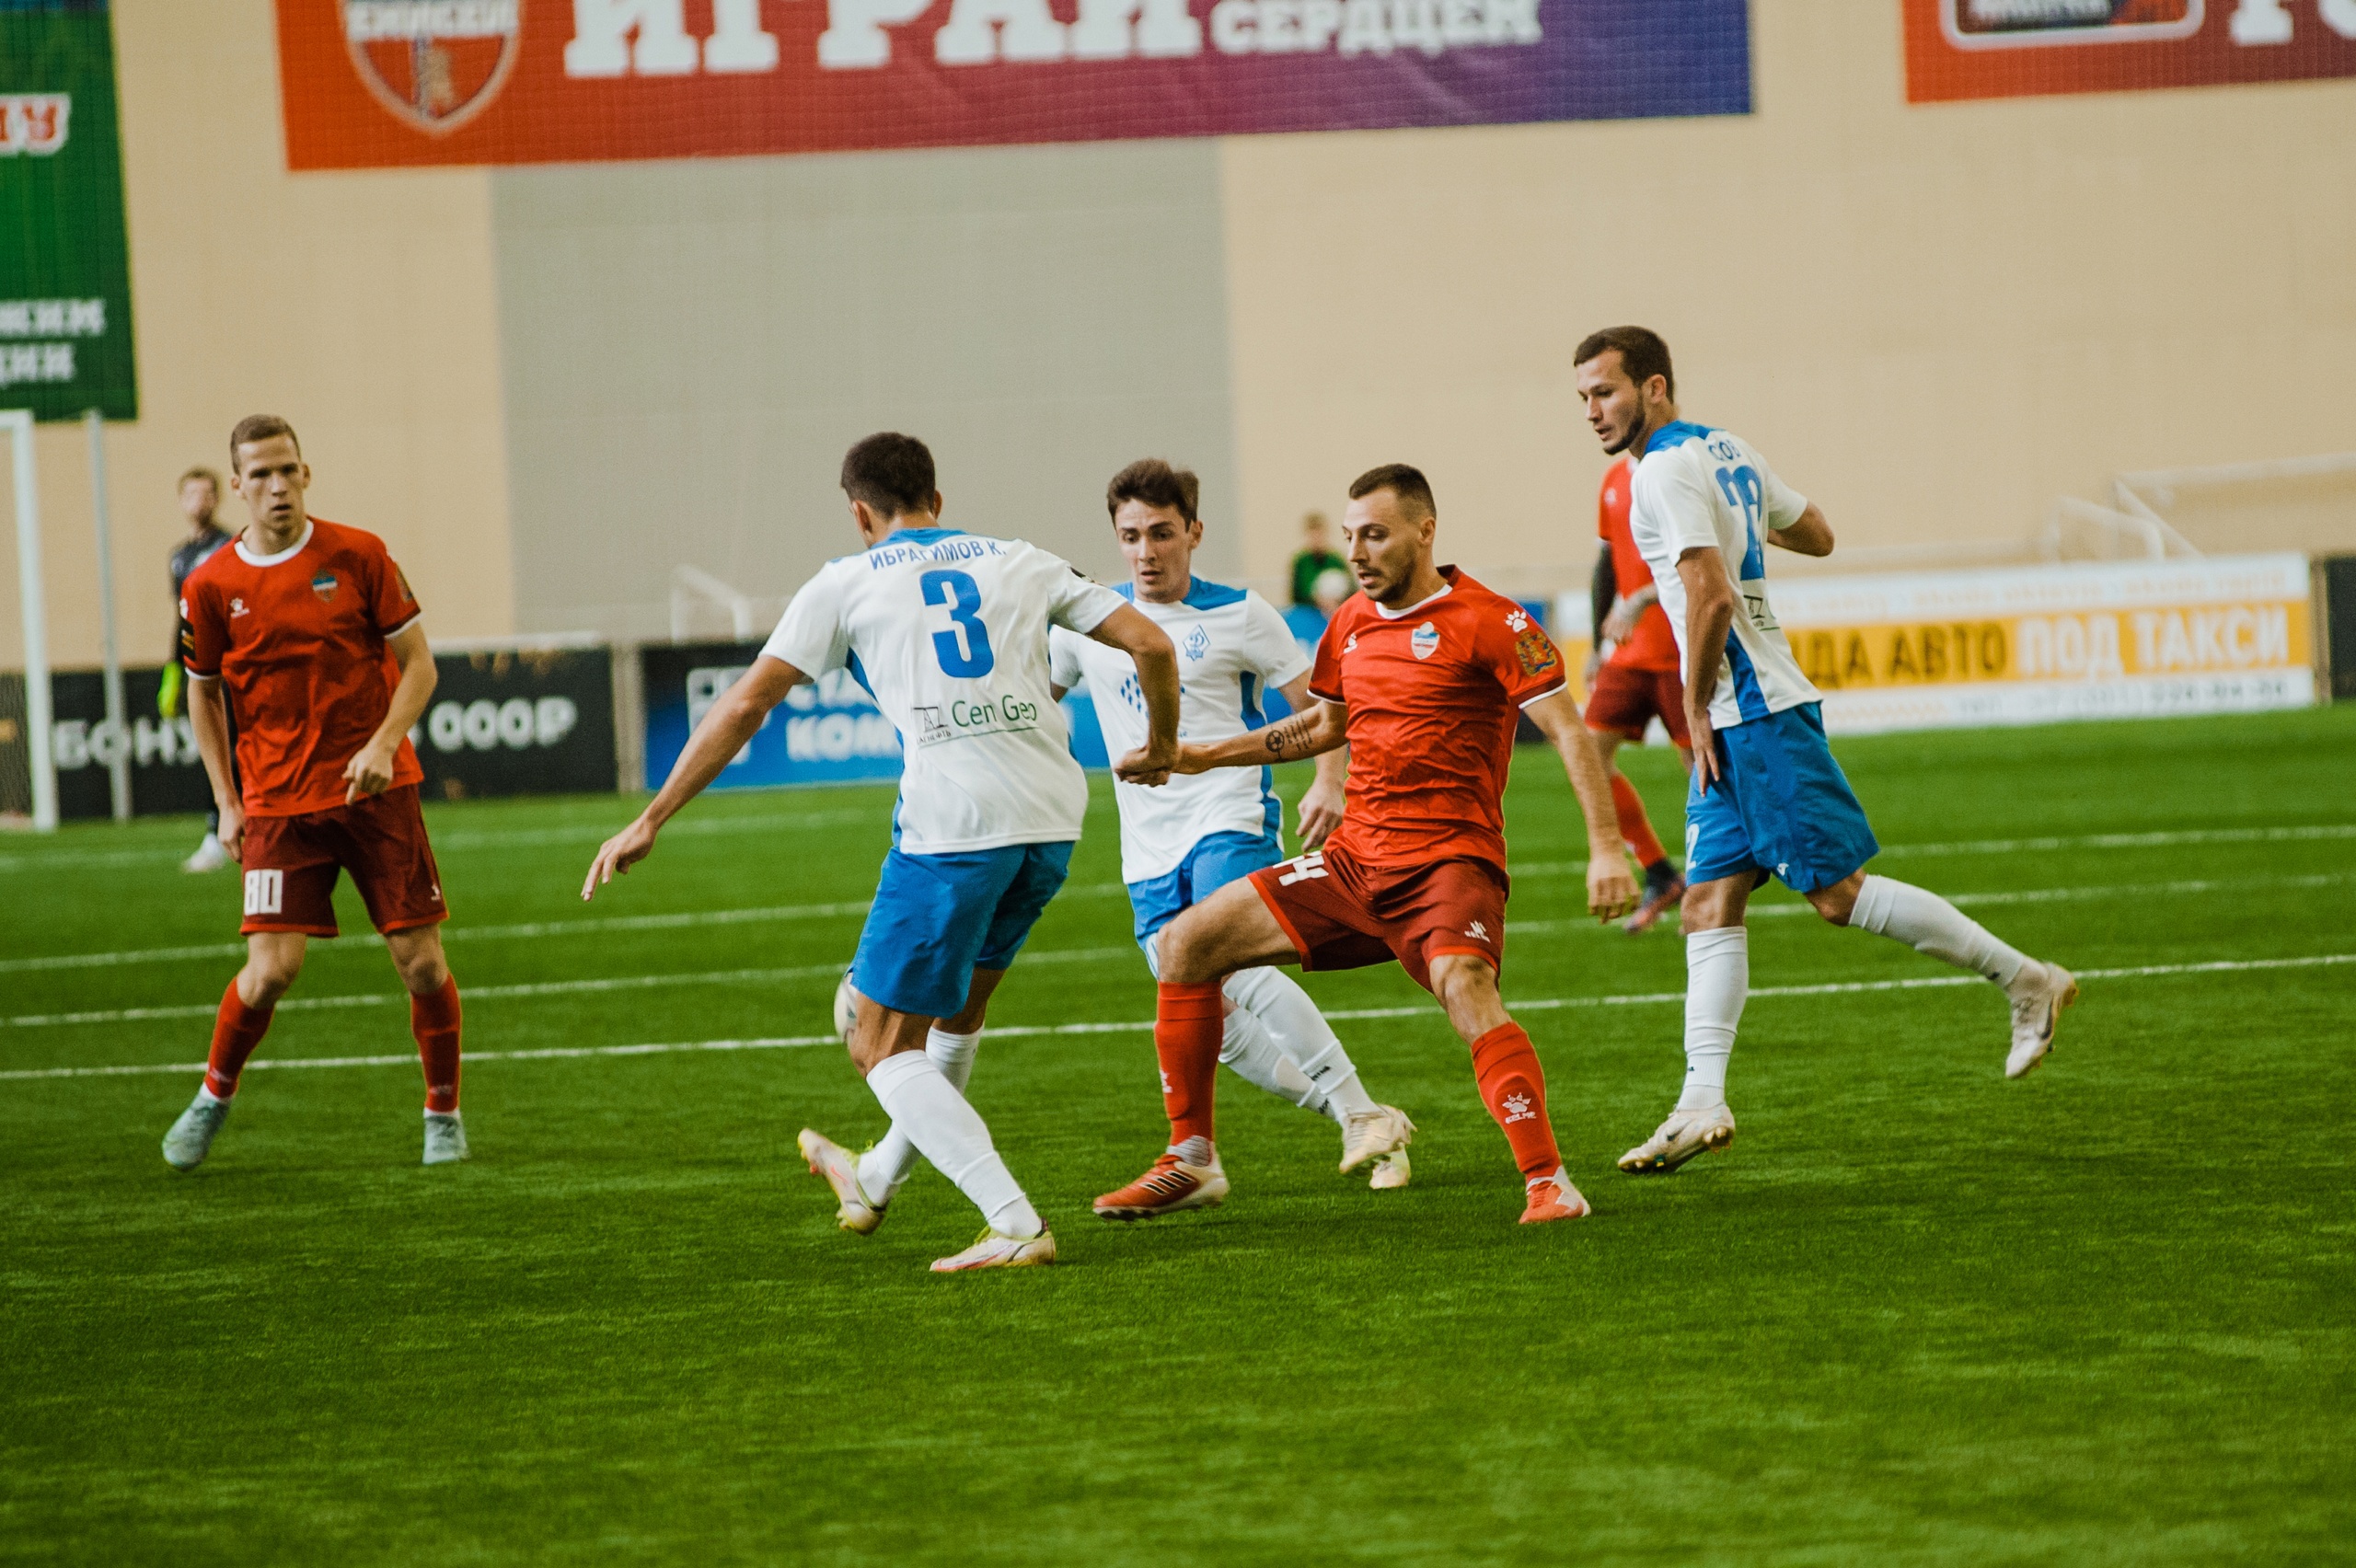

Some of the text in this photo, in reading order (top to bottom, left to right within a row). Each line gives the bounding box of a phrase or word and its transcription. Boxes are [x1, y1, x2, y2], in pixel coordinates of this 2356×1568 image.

[869, 540, 985, 571] ИБРАГИМОВ
[919, 569, 995, 678] 3
[1791, 602, 2290, 690] ДА АВТО ПОД ТАКСИ
[952, 694, 1038, 728] Cen Geo
[244, 869, 283, 916] 80
